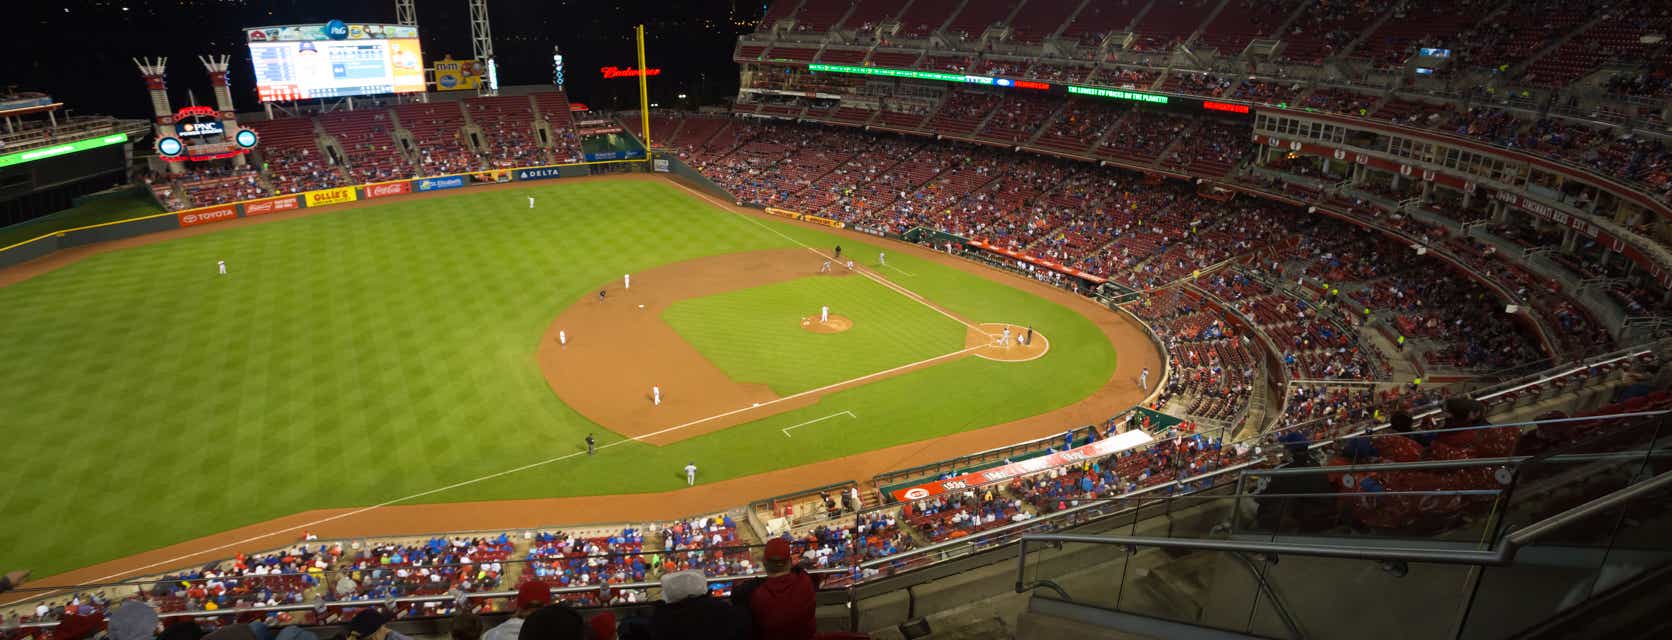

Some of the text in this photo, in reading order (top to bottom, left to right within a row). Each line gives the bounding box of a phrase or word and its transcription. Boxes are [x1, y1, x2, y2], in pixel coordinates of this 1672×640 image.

[194, 122, 216, 132] PNC
[530, 169, 559, 177] DELTA
[198, 209, 233, 221] TOYOTA
